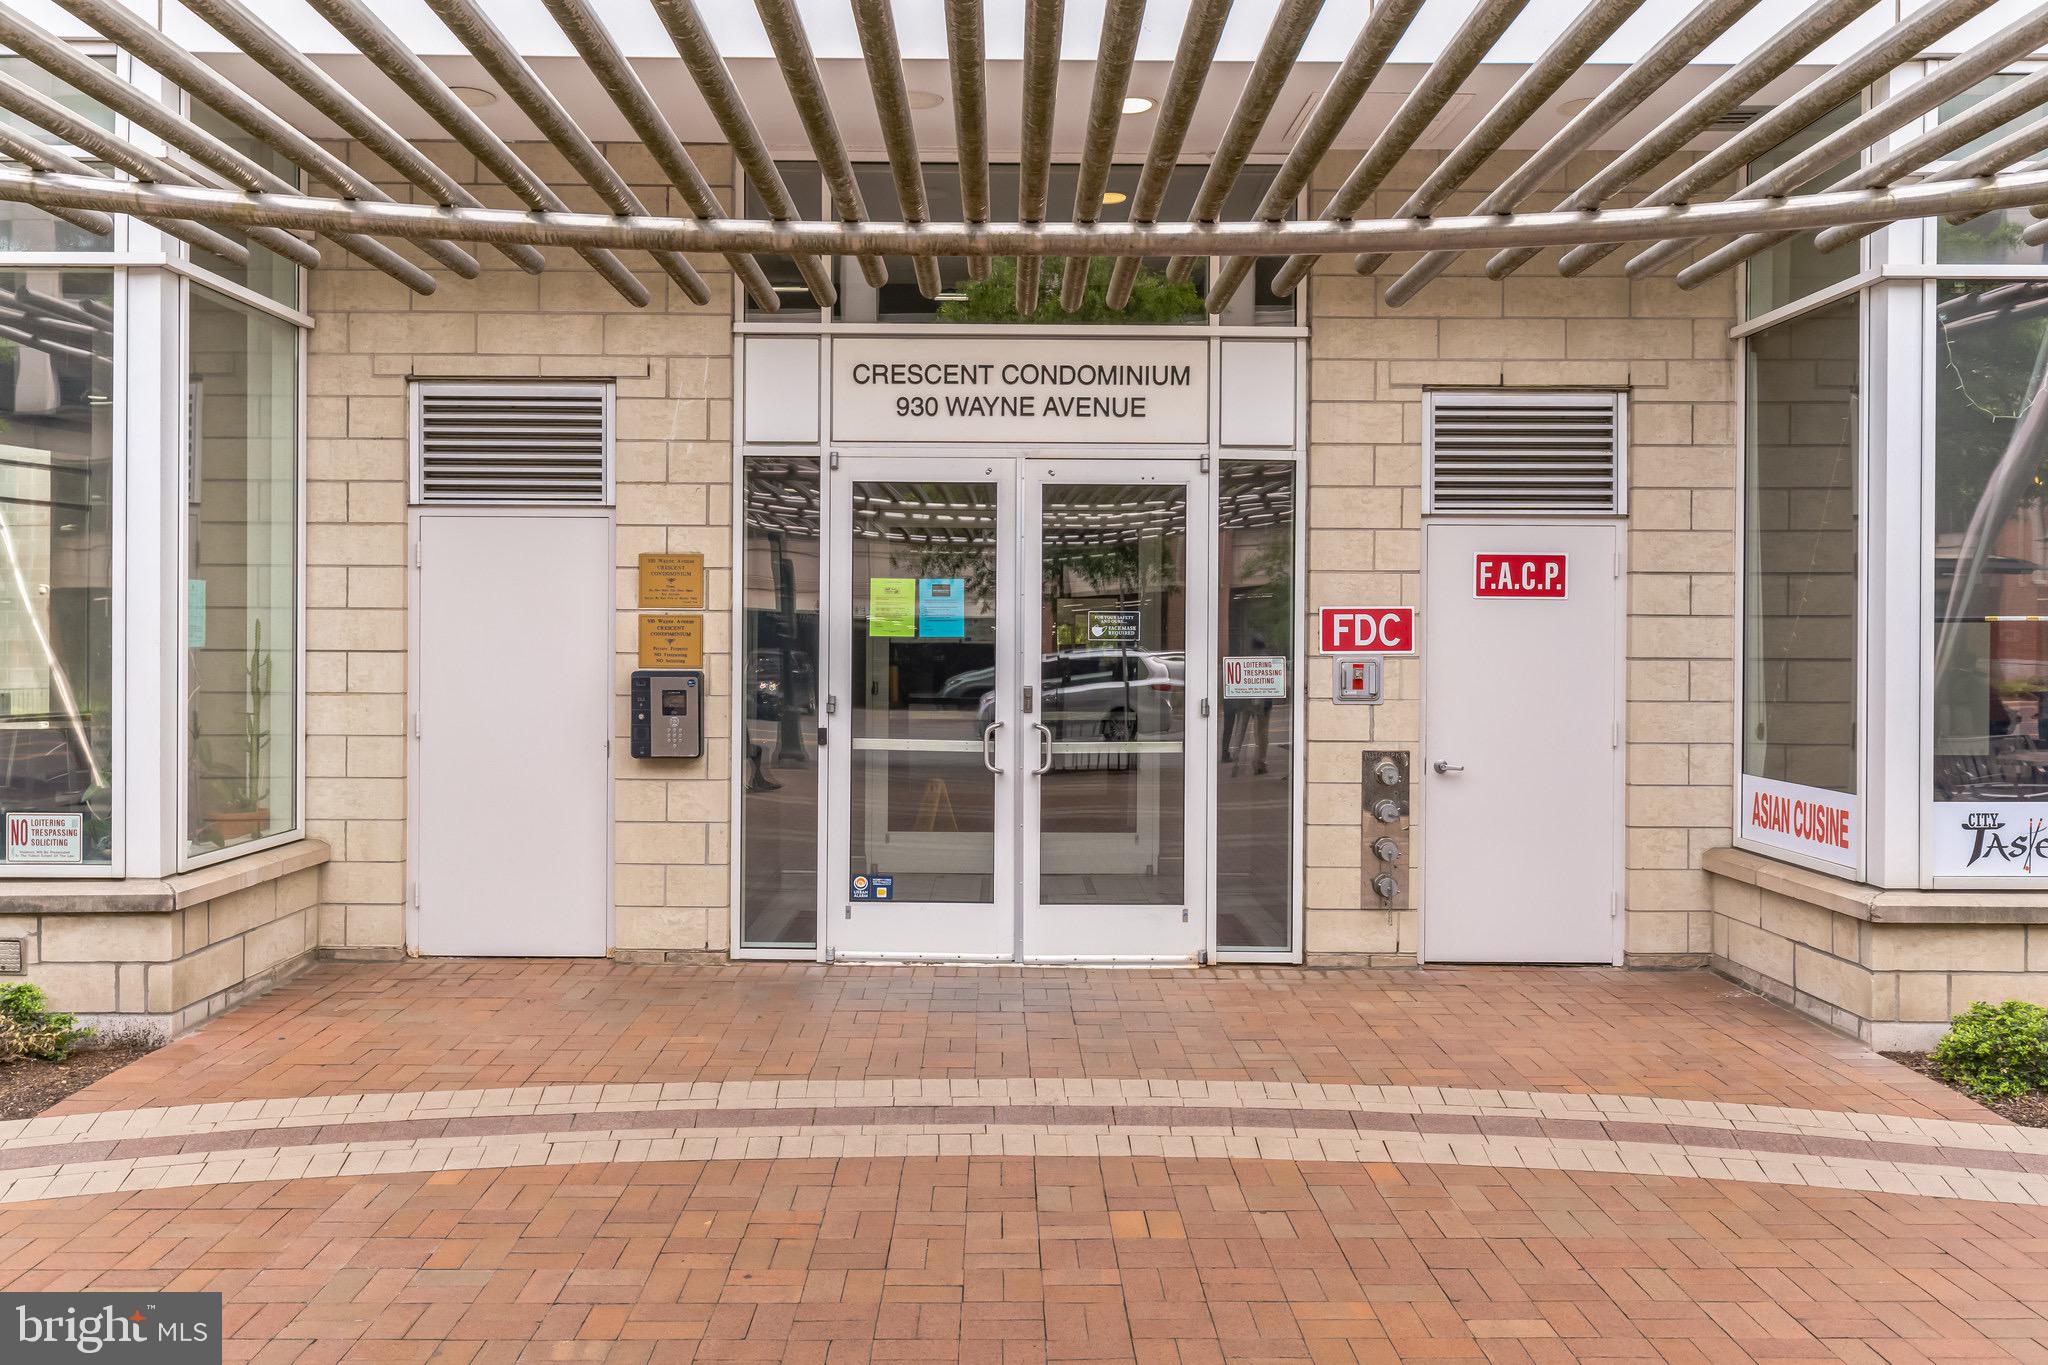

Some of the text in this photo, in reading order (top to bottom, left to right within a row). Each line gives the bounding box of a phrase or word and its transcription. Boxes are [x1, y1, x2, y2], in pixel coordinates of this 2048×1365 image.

[852, 363, 1191, 386] CRESCENT CONDOMINIUM
[896, 396, 1146, 418] 930 WAYNE AVENUE
[1480, 561, 1562, 590] F.A.C.P.
[1333, 613, 1401, 647] FDC
[1227, 661, 1242, 685] NO
[11, 819, 28, 846] NO
[1752, 791, 1849, 849] ASIAN CUISINE
[1968, 813, 1999, 827] CITY
